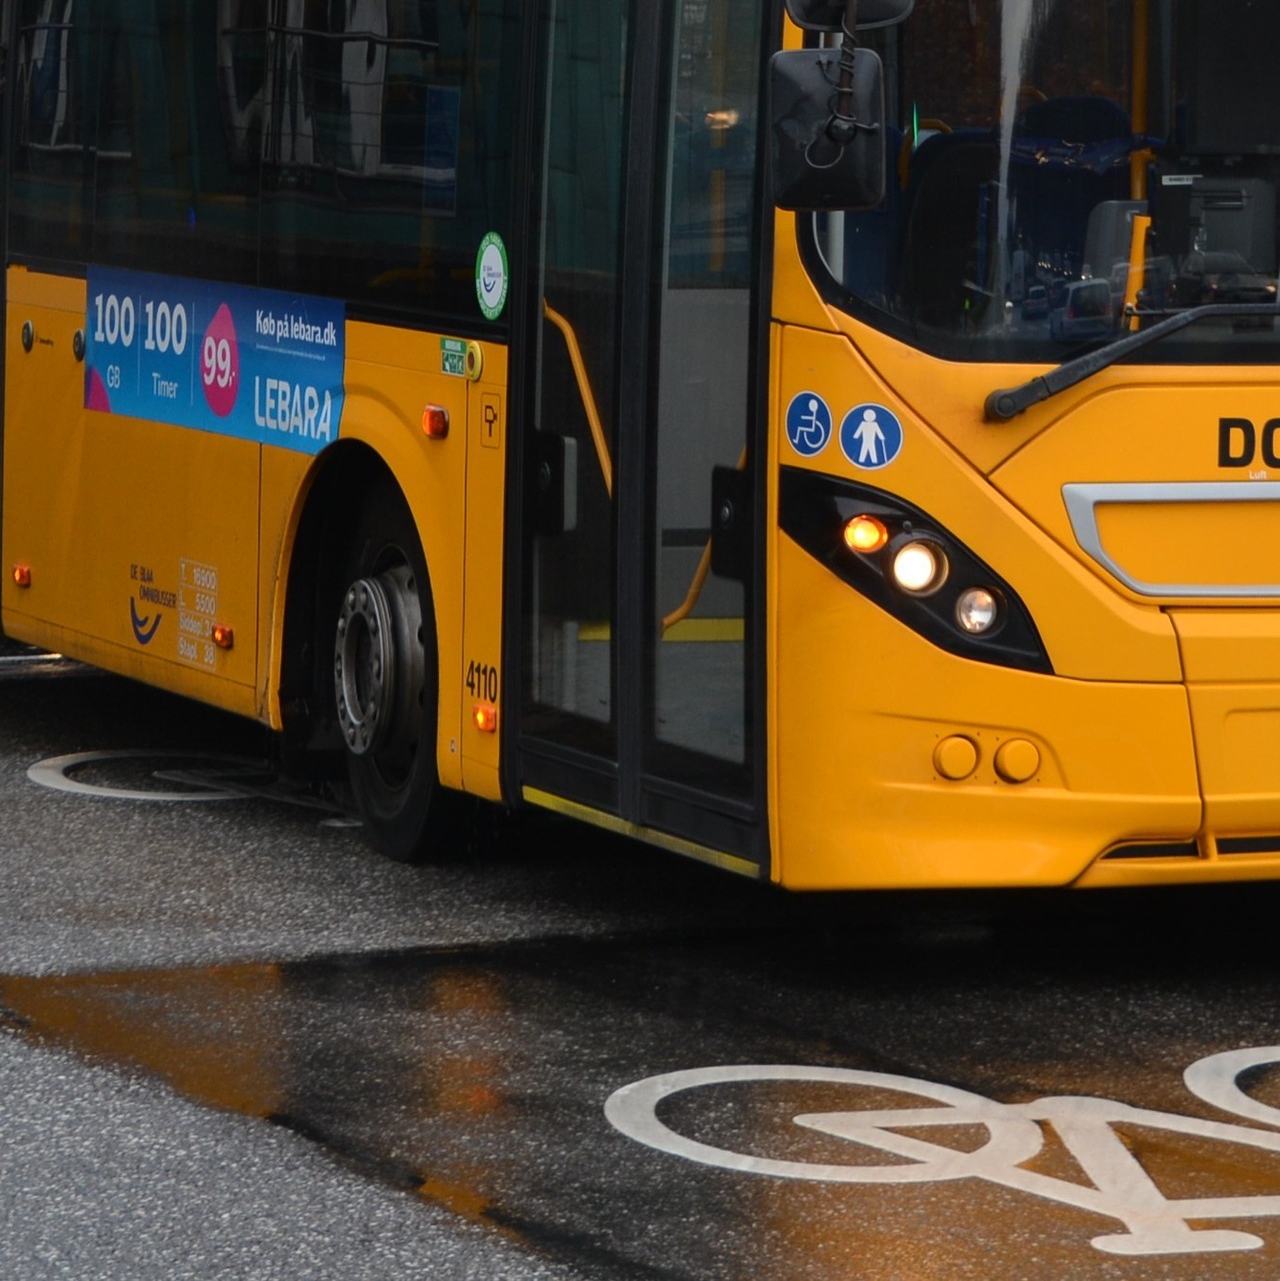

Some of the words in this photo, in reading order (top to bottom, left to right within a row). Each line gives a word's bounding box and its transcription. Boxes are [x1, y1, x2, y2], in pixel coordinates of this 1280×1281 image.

[95, 294, 135, 347] 100
[145, 300, 187, 355] 100
[256, 310, 275, 335] Køb
[276, 314, 289, 344] på
[290, 315, 337, 346] lebara.dk
[107, 364, 120, 389] GB
[152, 372, 178, 399] Timer
[254, 376, 332, 442] LEBARA
[466, 660, 497, 704] 4110
